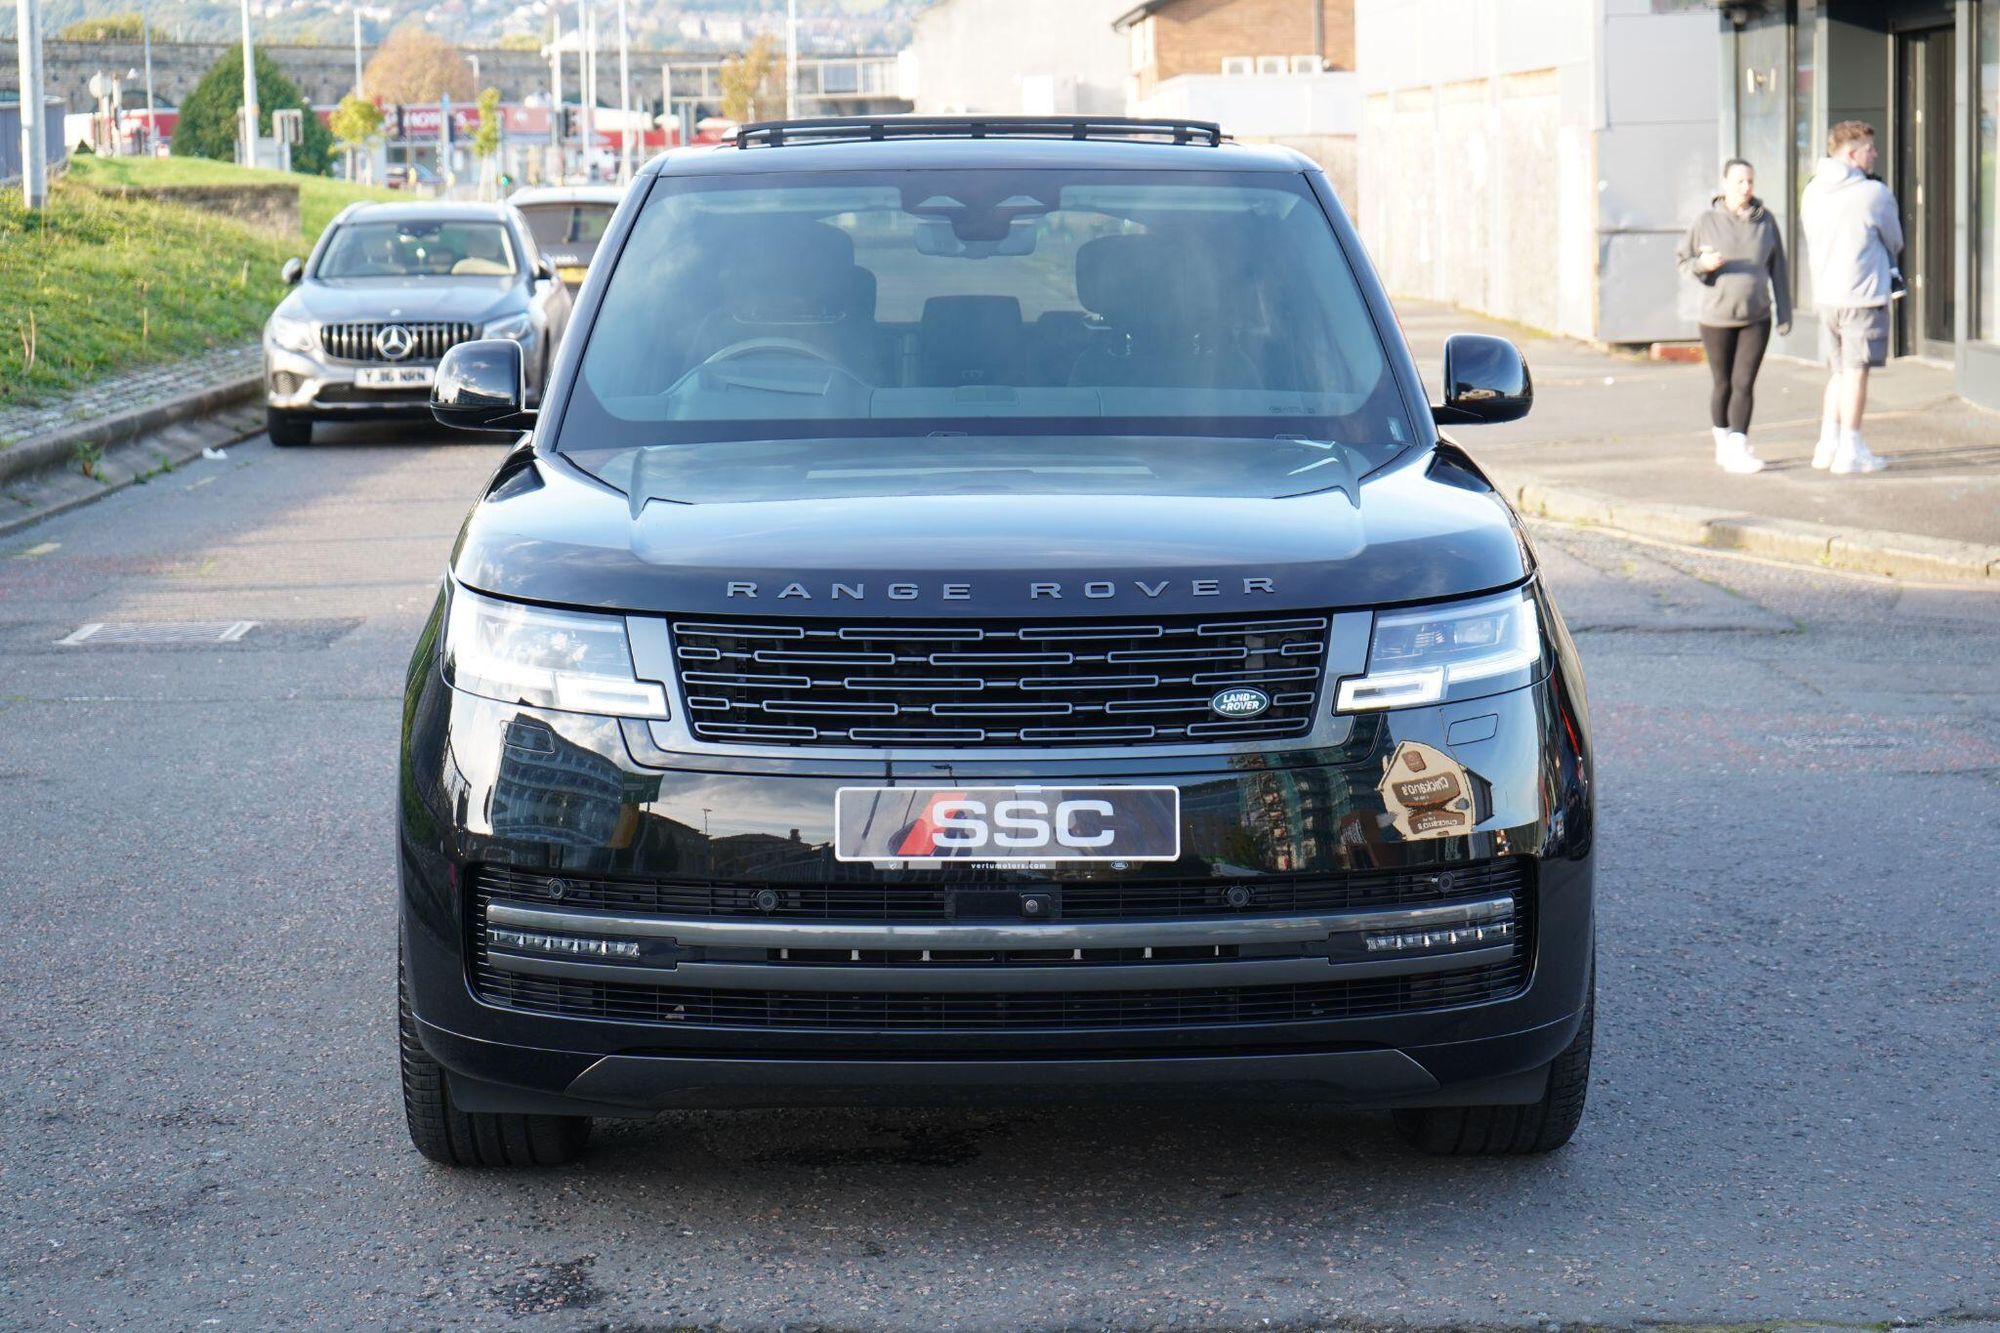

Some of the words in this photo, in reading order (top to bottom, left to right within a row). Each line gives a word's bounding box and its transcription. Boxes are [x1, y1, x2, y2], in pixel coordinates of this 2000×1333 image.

[727, 581, 971, 600] RANGE
[1030, 577, 1275, 600] ROVER
[1223, 693, 1251, 703] LAND
[1226, 701, 1260, 711] ROVER
[932, 800, 1114, 847] SSC
[970, 862, 1047, 870] vertumotors.com
